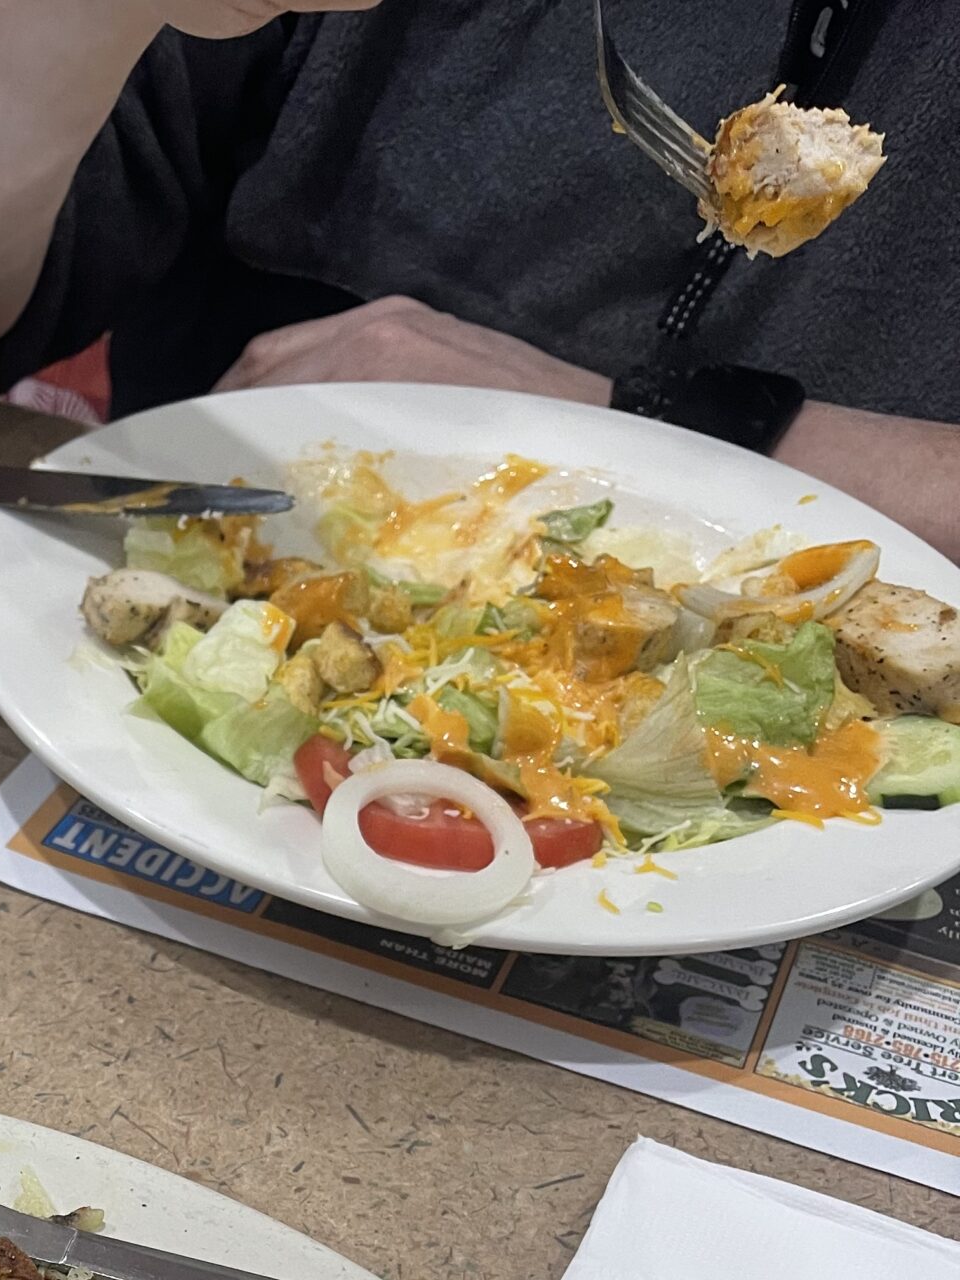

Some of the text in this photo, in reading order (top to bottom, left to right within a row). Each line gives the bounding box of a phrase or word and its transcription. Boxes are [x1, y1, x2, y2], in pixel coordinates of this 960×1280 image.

[380, 939, 488, 978] MORE THAN
[816, 998, 879, 1023] Operated
[802, 1027, 876, 1057] Service
[892, 1031, 944, 1053] Licensed
[897, 1022, 947, 1044] Owned
[880, 1051, 923, 1075] Tree
